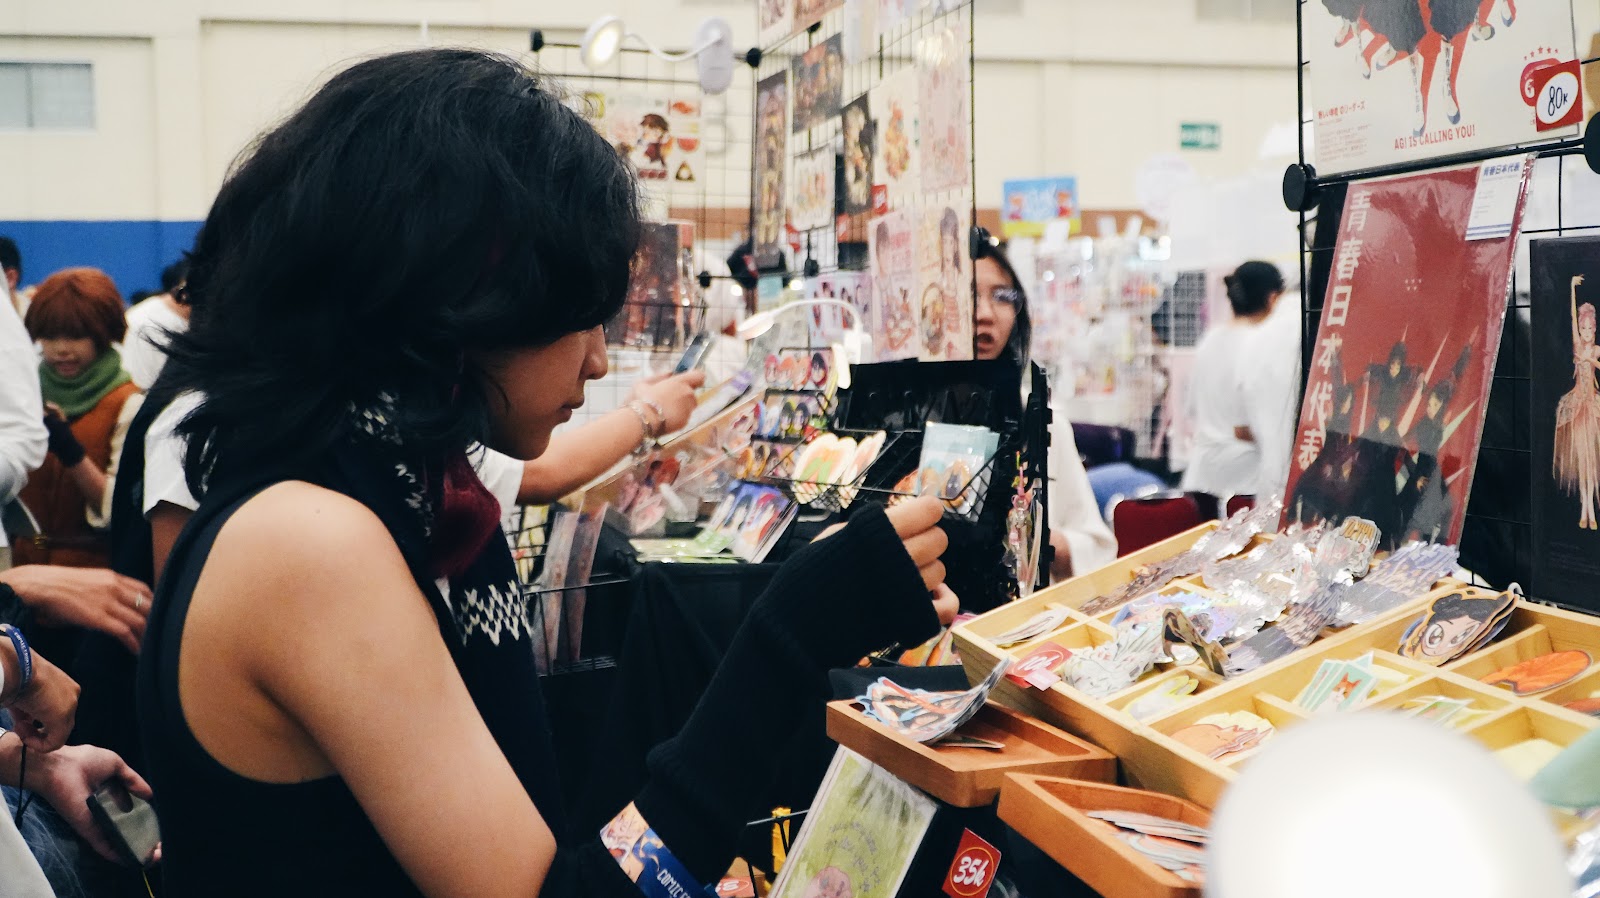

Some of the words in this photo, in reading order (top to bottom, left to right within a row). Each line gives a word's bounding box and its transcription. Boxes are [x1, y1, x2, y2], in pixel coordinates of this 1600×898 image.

[1409, 135, 1418, 148] IS
[1419, 128, 1454, 146] CALLING
[1455, 123, 1476, 140] YOU!
[1297, 190, 1372, 472] 青春日本代表
[656, 868, 684, 898] COMIC
